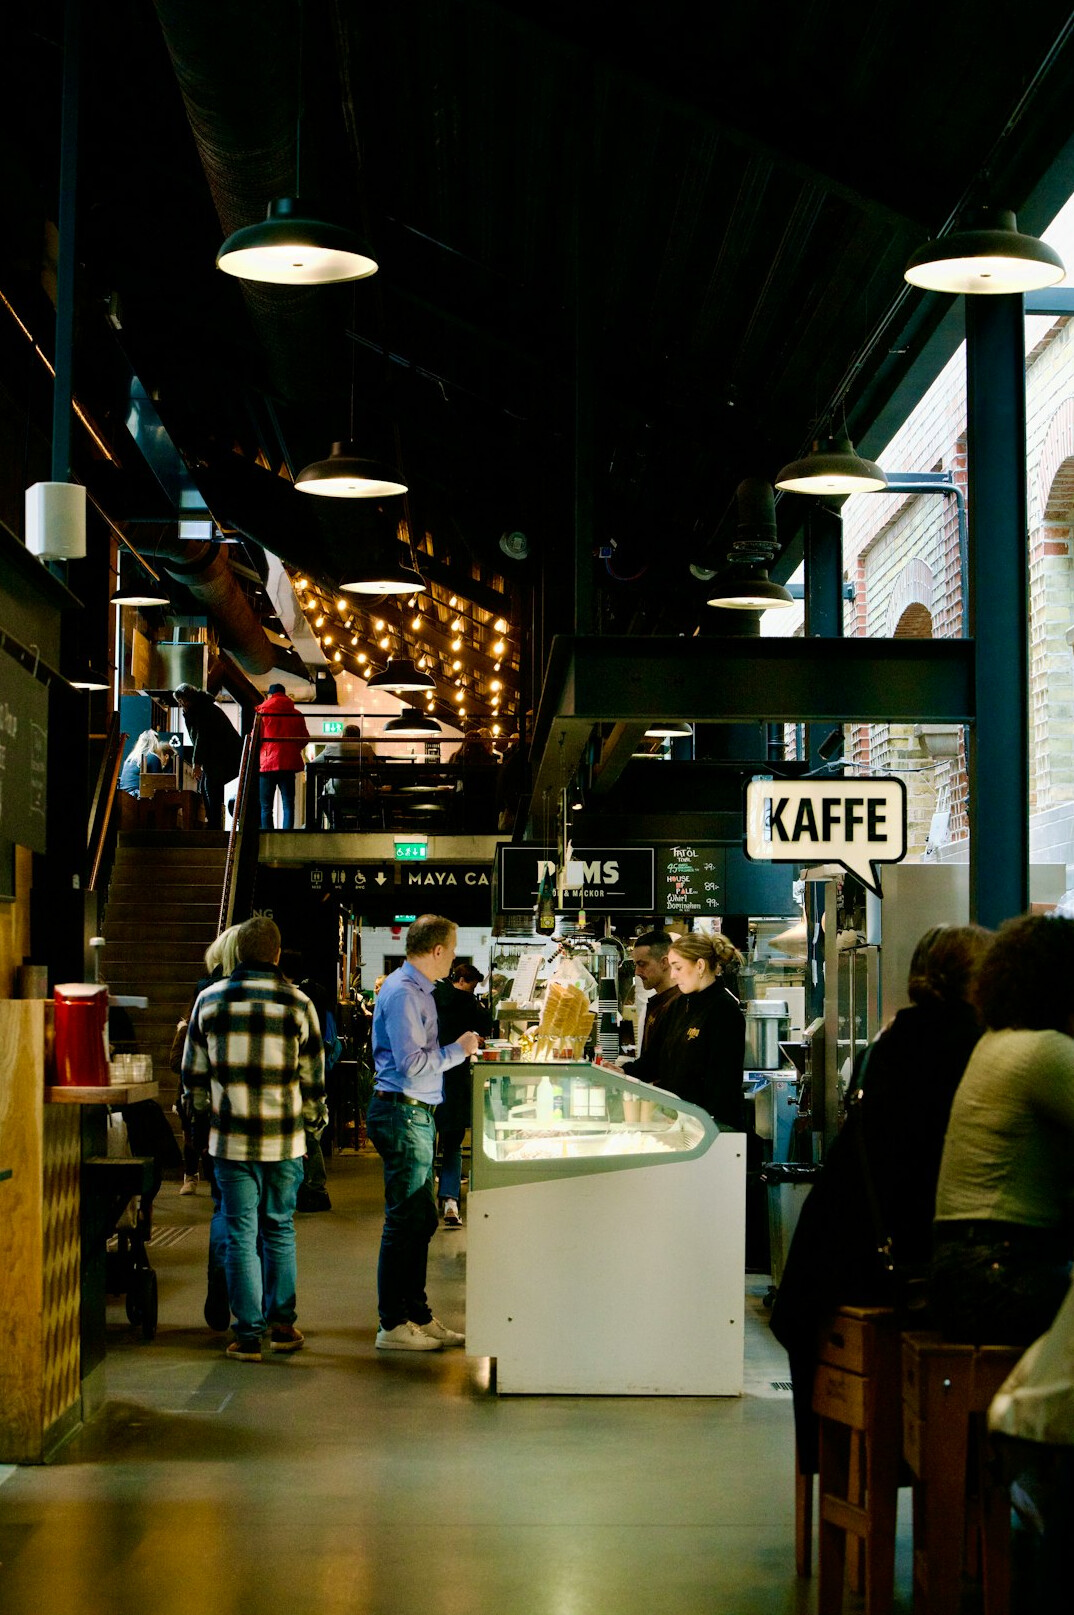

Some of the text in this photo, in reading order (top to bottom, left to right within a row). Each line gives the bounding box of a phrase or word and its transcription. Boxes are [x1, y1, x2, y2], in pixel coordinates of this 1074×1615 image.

[764, 797, 888, 842] KAFFE
[408, 872, 458, 886] MAYA
[537, 860, 619, 884] PMS
